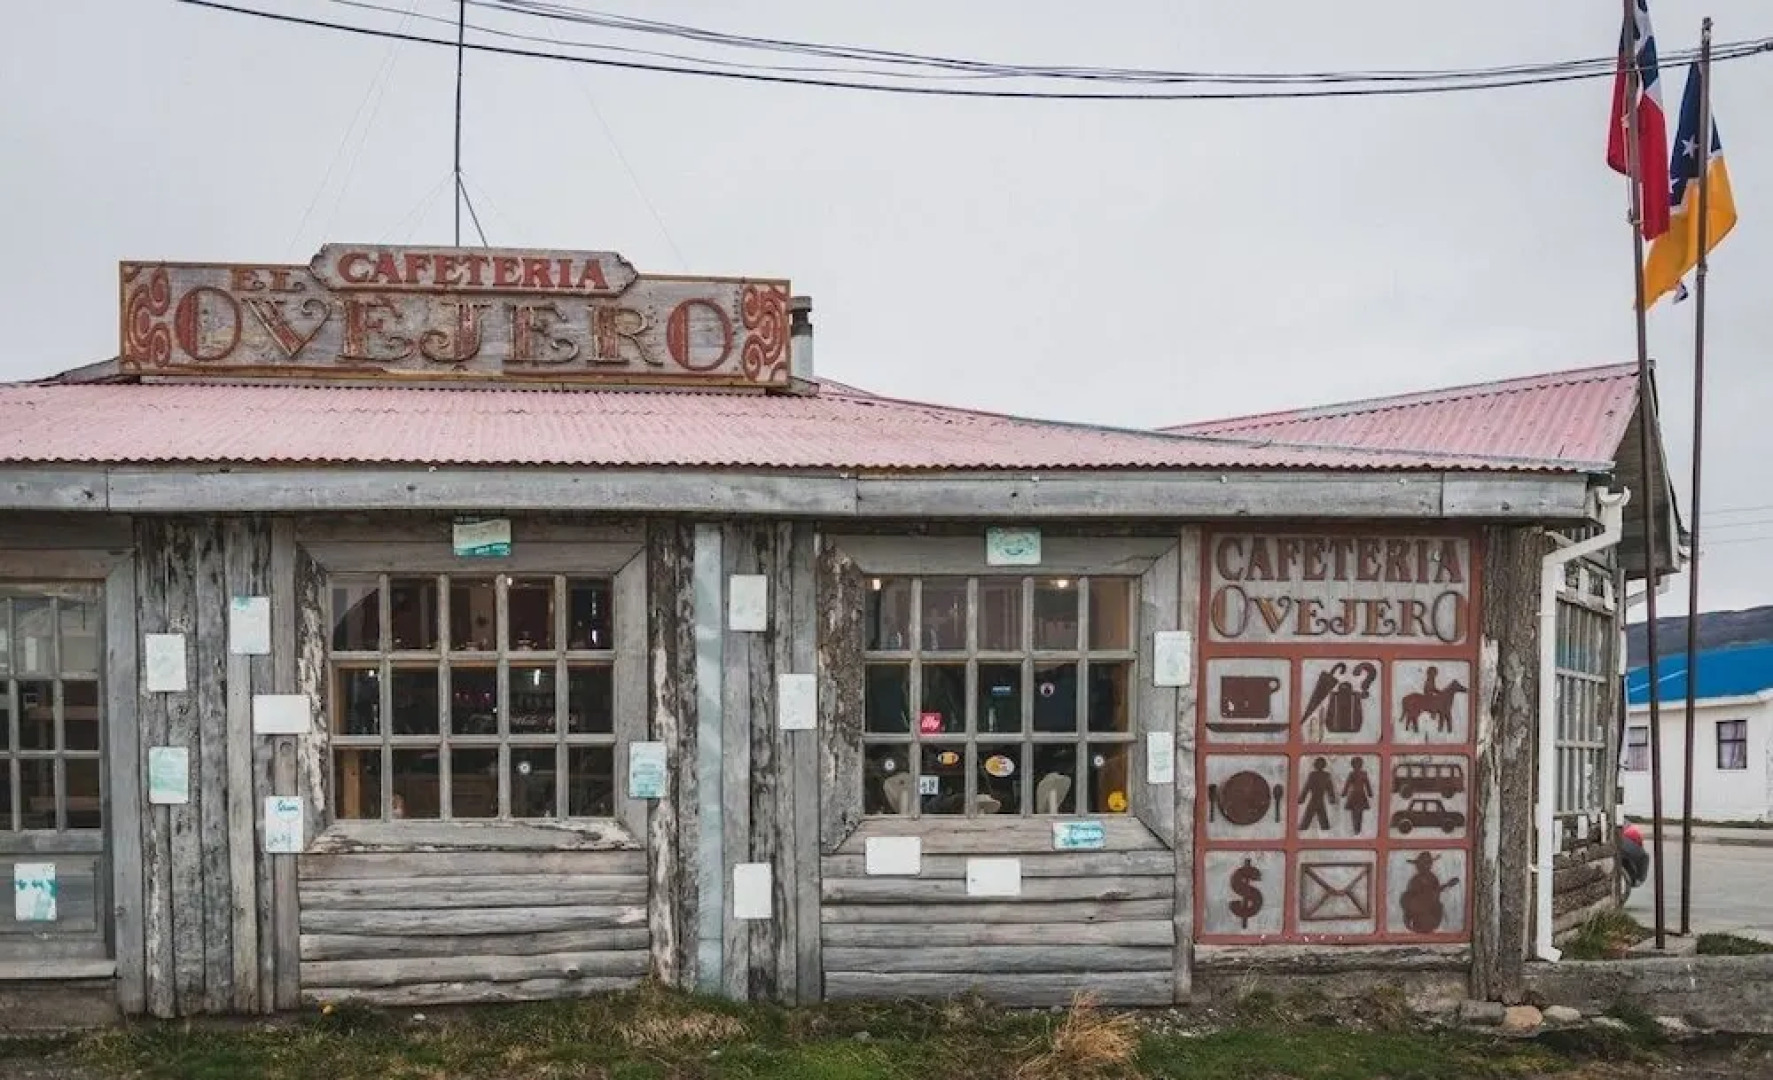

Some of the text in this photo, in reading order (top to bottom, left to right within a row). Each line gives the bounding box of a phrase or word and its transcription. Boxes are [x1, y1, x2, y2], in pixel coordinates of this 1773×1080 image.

[229, 266, 306, 293] EL
[337, 251, 609, 290] CAFETERIA
[173, 285, 733, 372] OVEJERO
[1216, 536, 1466, 584] CAFETERIA
[1210, 584, 1468, 643] OVEJERO
